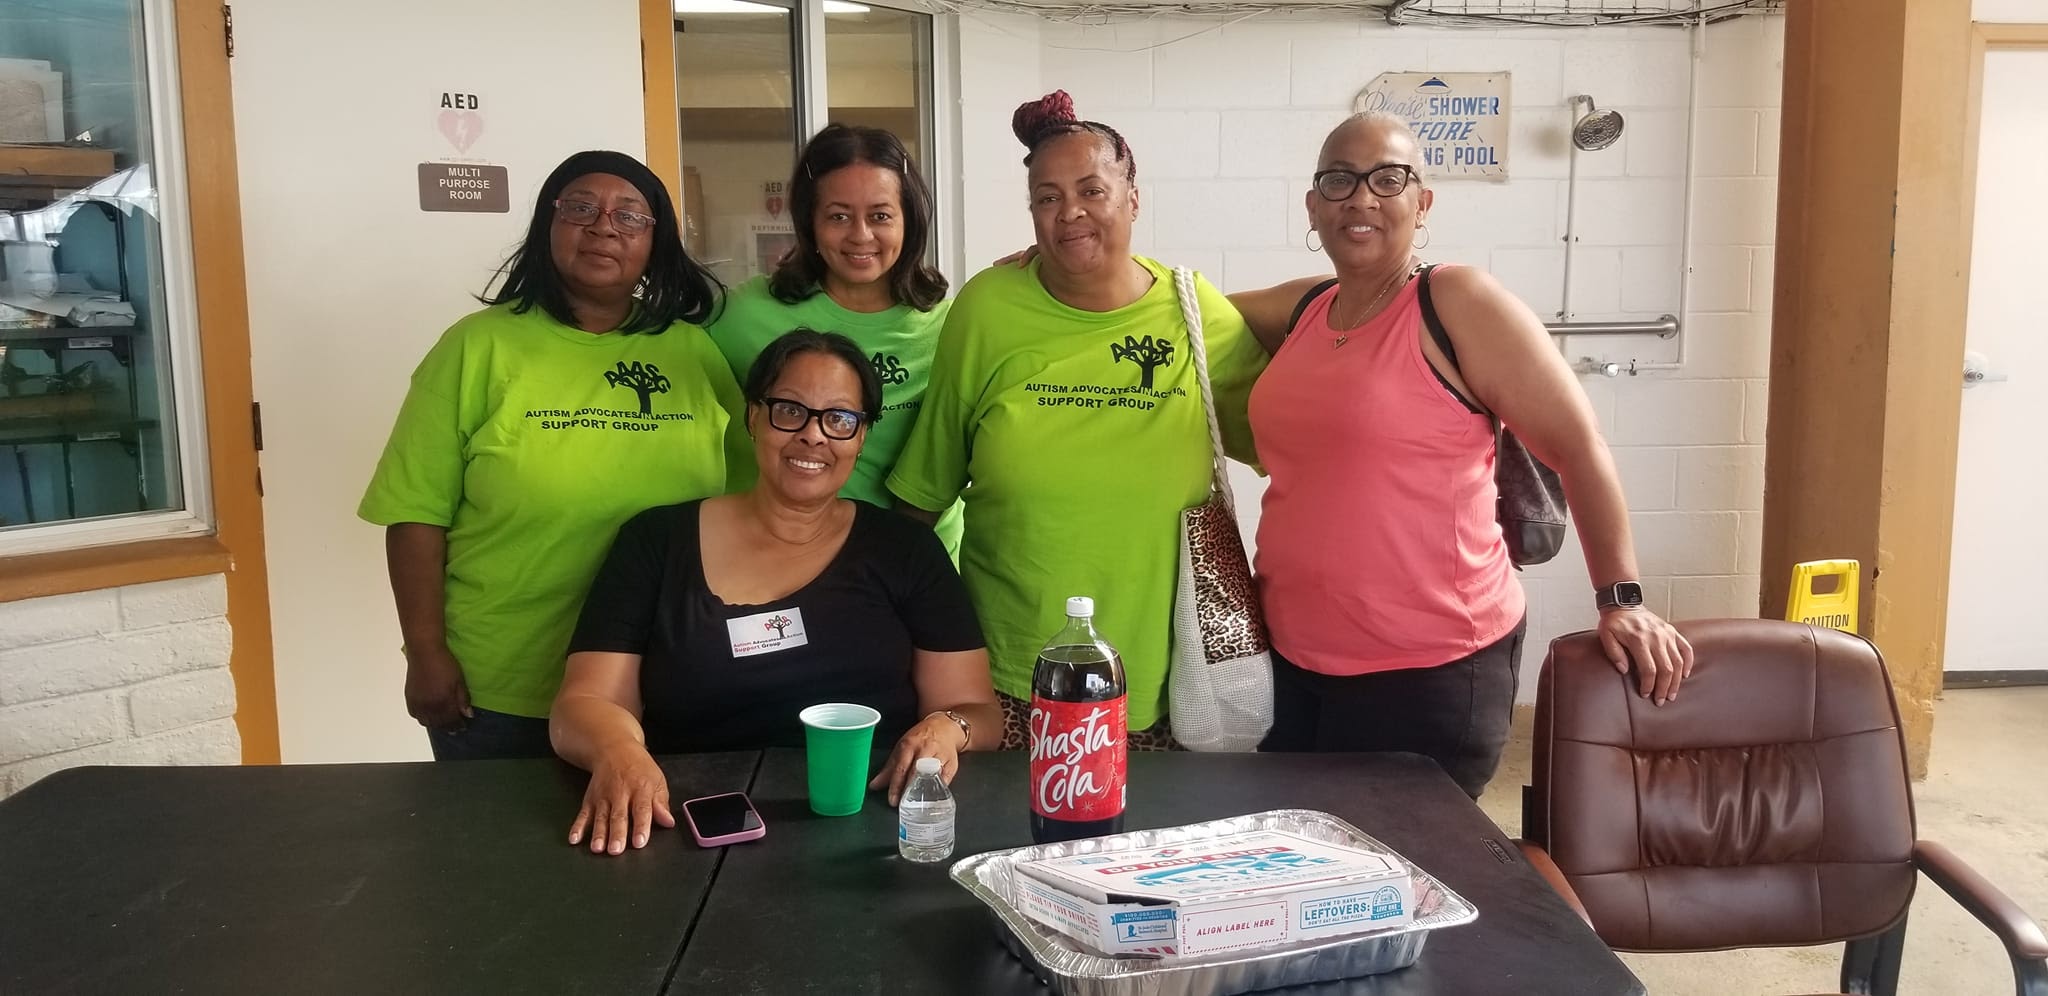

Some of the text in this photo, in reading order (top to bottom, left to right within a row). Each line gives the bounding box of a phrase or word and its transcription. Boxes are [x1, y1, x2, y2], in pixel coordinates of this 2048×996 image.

[440, 92, 479, 110] AED
[1429, 96, 1500, 116] SHOWER
[1409, 121, 1477, 141] FORE
[1454, 146, 1499, 166] POOL
[448, 167, 481, 178] MULTI
[439, 178, 491, 189] PURPOSE
[765, 182, 783, 193] AED
[449, 190, 482, 200] ROOM
[1024, 383, 1069, 394] AUTISM
[1071, 385, 1138, 396] ADVOCATES
[881, 401, 920, 411] ACTION
[1037, 396, 1155, 412] SUPPORT GROUP
[525, 409, 571, 419] AUTISM
[573, 407, 639, 419] ADVOCATES
[655, 412, 694, 421] ACTION
[541, 418, 659, 432] SUPPORT GROUP
[1803, 614, 1850, 628] CAUTION
[734, 641, 782, 653] Support Group
[1030, 706, 1118, 766] Shasta
[1040, 763, 1104, 814] Cola
[1105, 865, 1139, 875] DO
[1142, 856, 1204, 869] YOUR
[1135, 857, 1340, 887] RECYCLE
[1304, 902, 1370, 921] LEFTOVERS:
[1196, 926, 1223, 937] ALIGN
[1225, 922, 1250, 933] LABEL
[1253, 918, 1275, 929] HERE
